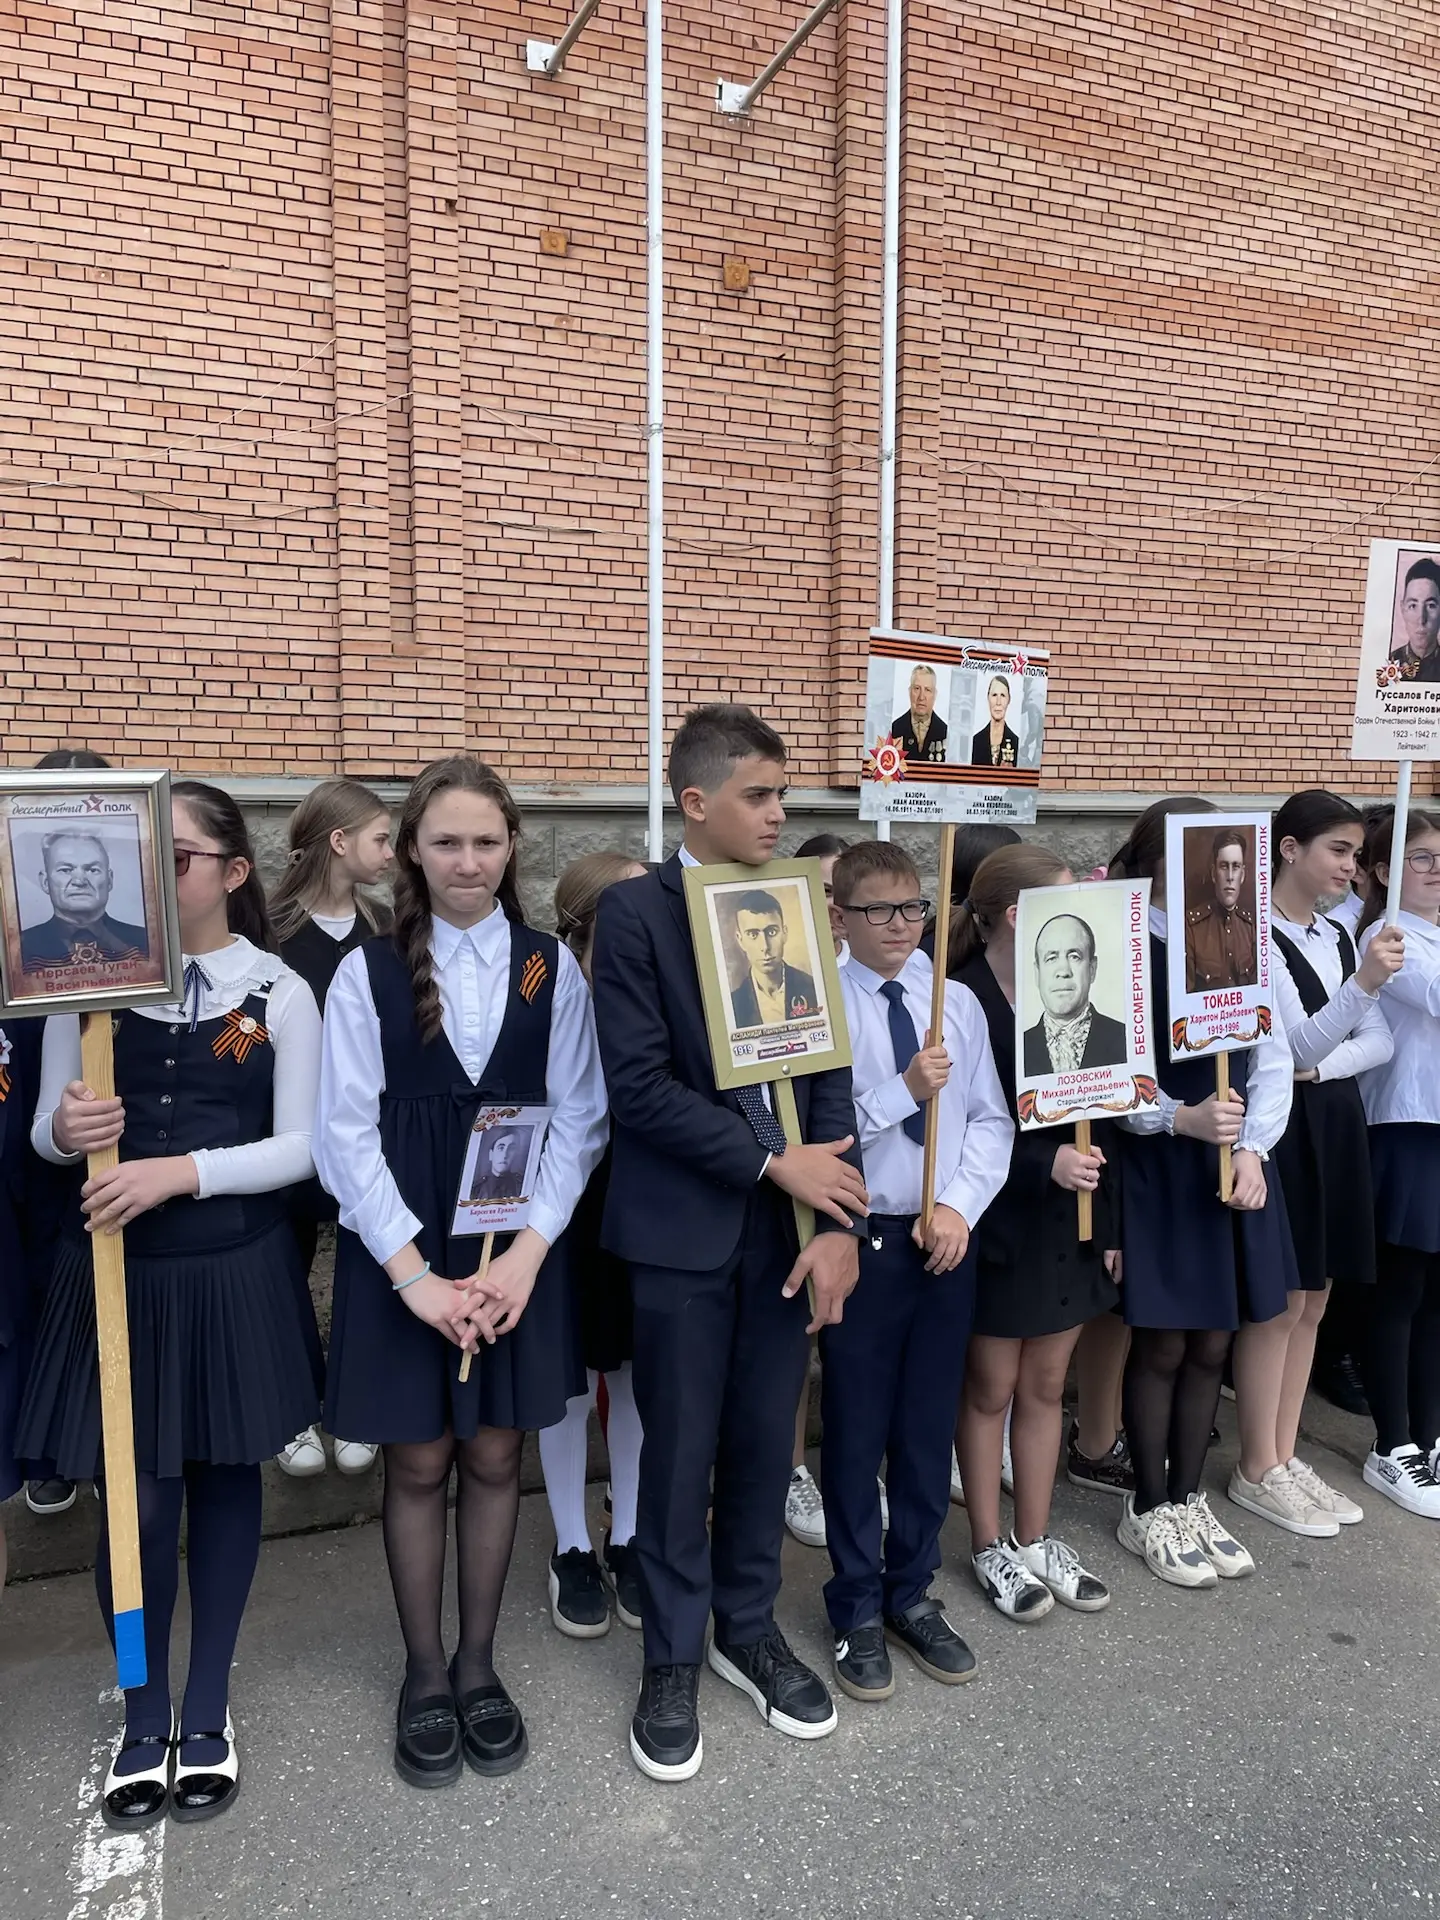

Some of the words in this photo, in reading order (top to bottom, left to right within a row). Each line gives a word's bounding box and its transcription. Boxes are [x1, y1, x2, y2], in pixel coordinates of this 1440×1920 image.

[1375, 689, 1421, 700] Гуссалов
[1424, 691, 1440, 702] Гер
[1384, 703, 1440, 714] Харитонови
[1355, 716, 1373, 726] Орден
[1375, 716, 1416, 725] Отечественной
[1418, 717, 1435, 725] Войны
[1392, 730, 1408, 738] 1923
[1415, 730, 1430, 738] 1942
[1397, 742, 1426, 750] Лейтенант
[1259, 825, 1268, 866] ПОЛК
[1131, 891, 1142, 932] ПОЛК
[1257, 871, 1269, 988] БЕССМЕРТНЫЙ
[36, 965, 96, 979] Персаев
[45, 976, 131, 992] Васильевич
[1129, 937, 1146, 1055] БЕССМЕРТНЫЙ
[1203, 991, 1243, 1009] ТОКАЕВ
[1190, 1014, 1219, 1025] Харитон
[1220, 1008, 1255, 1022] Дзибаевич
[731, 1030, 762, 1041] АСЛАНИДИ
[763, 1025, 788, 1036] Пантелей
[1207, 1021, 1240, 1035] 1919-1996
[809, 1031, 828, 1042] 1942
[733, 1044, 753, 1056] 1919
[1057, 1068, 1112, 1086] ЛОЗОВСКИЙ
[1041, 1088, 1075, 1100] Михаил
[1077, 1081, 1130, 1095] Аркадьевич
[1057, 1096, 1087, 1106] Старший
[1087, 1093, 1115, 1102] сержант
